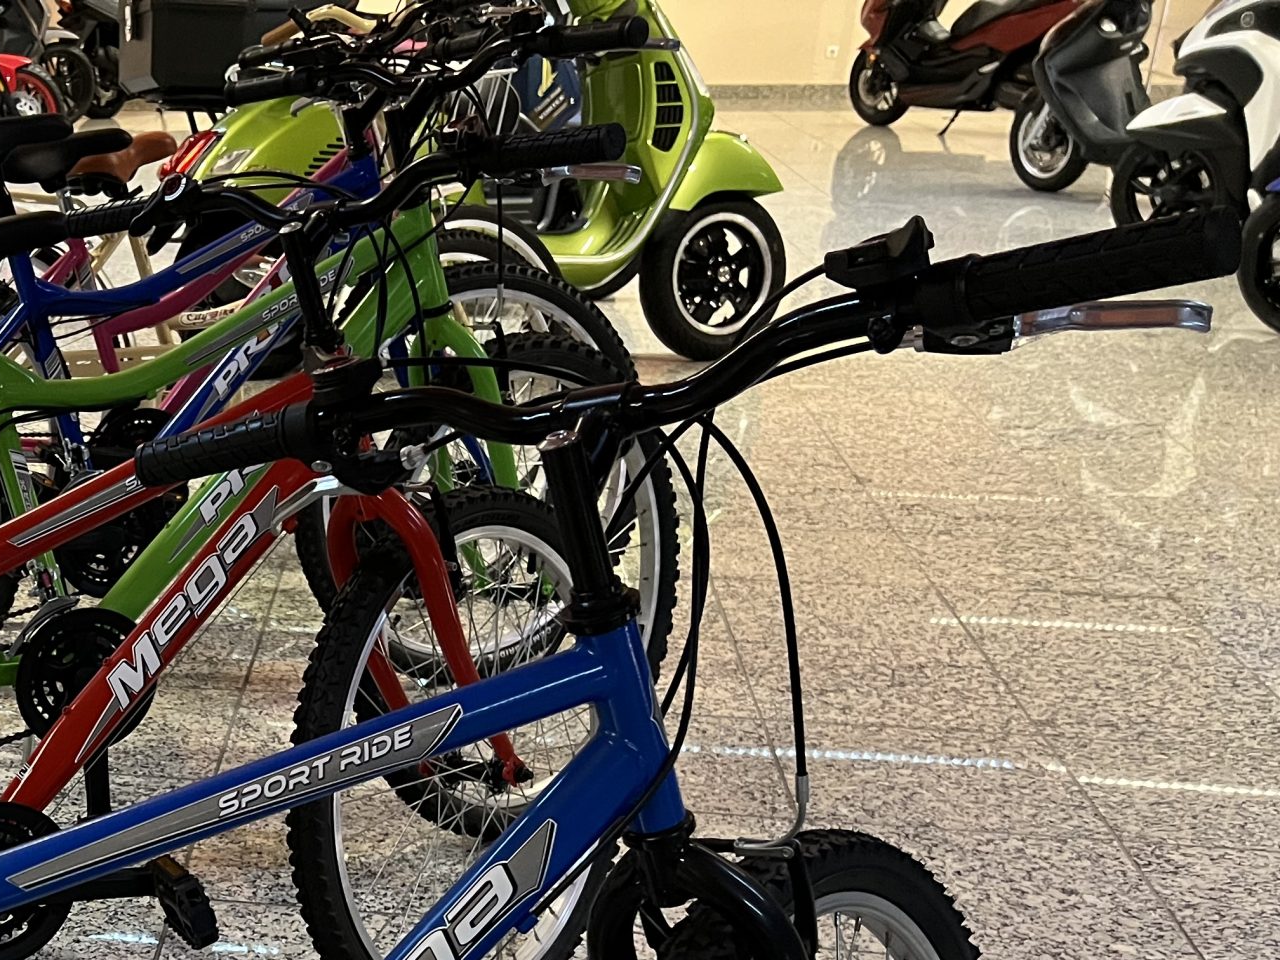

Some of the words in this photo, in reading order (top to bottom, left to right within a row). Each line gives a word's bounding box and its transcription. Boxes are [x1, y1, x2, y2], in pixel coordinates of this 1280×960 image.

[240, 223, 265, 242] SPO
[262, 296, 298, 321] SPOR
[106, 512, 258, 712] Mega
[218, 755, 333, 817] SPORT
[339, 724, 414, 772] RIDE
